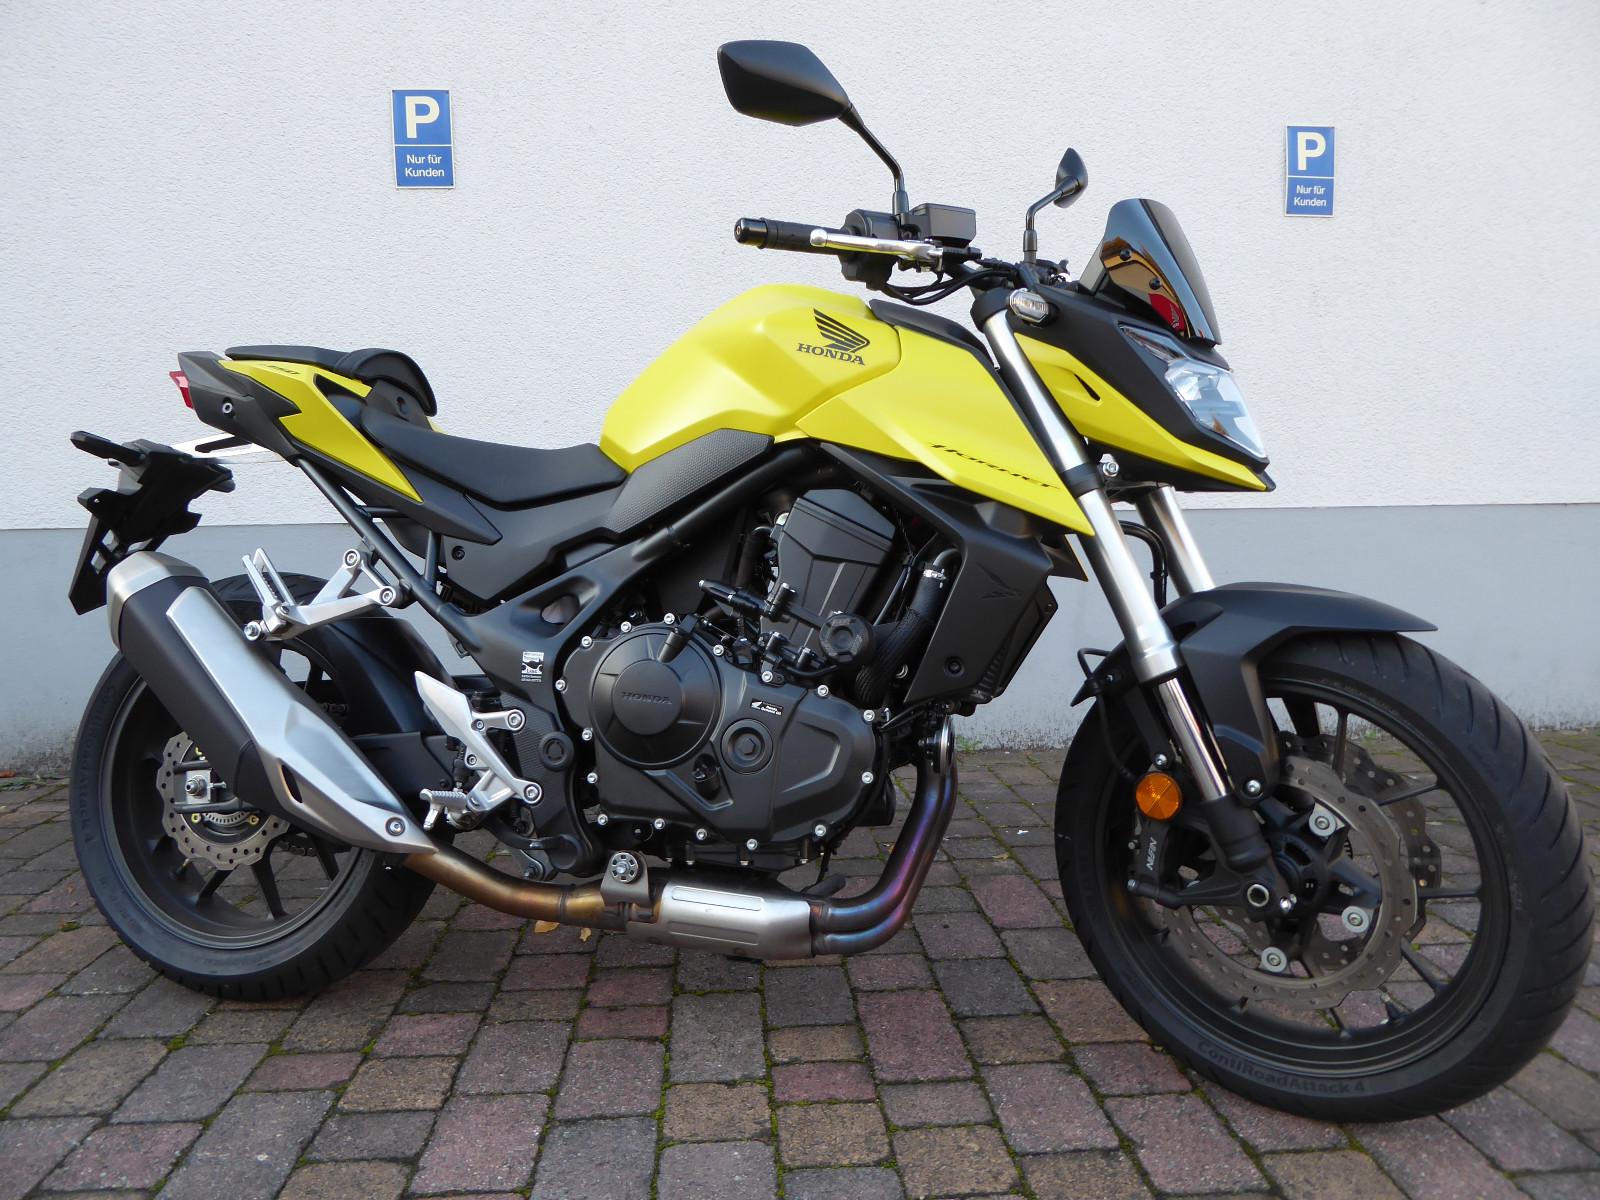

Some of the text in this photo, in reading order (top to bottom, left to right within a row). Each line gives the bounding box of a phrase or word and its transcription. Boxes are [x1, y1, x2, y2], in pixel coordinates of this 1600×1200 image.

[405, 95, 440, 139] P
[1297, 131, 1326, 171] P
[406, 154, 442, 164] Nur für
[405, 167, 445, 177] Kunden
[1296, 184, 1326, 195] Nur für
[1293, 197, 1327, 207] Kunden
[796, 342, 866, 366] HONDA
[621, 690, 673, 705] HONDA
[1197, 1040, 1366, 1094] ContiRoadAttack 4
